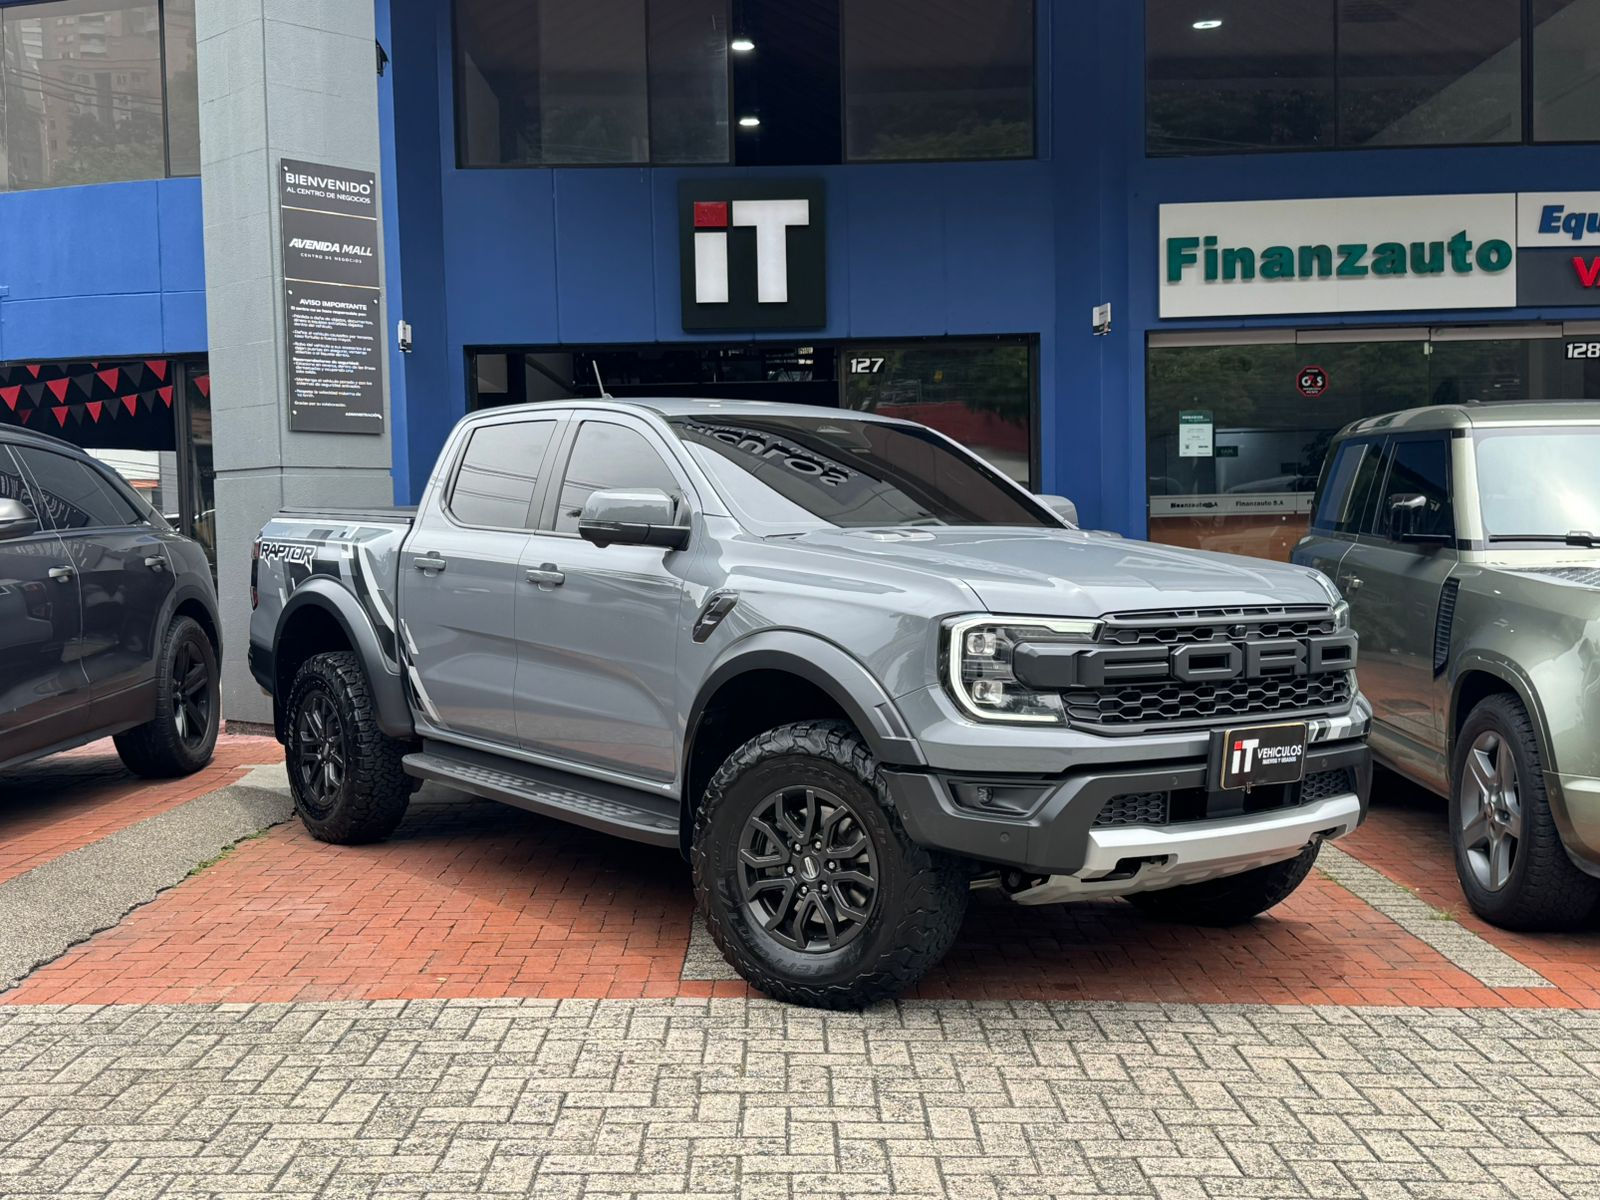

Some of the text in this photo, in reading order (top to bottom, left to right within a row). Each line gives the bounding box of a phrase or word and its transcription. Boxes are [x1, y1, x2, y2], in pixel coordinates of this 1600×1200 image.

[286, 172, 370, 194] BIENVENIDO
[297, 188, 325, 198] CENTRO
[337, 193, 371, 204] NEGOCIOS
[289, 238, 373, 256] AVENIDA MALL
[1166, 230, 1513, 282] Finanzauto
[1572, 256, 1600, 288] V
[300, 298, 320, 307] AVISO
[322, 300, 367, 310] IMPORTANTE
[1567, 342, 1600, 358] 128
[851, 358, 884, 374] 127
[260, 542, 317, 574] RAPTOR
[1074, 631, 1358, 688] FORD
[1257, 745, 1302, 759] VEHICULOS
